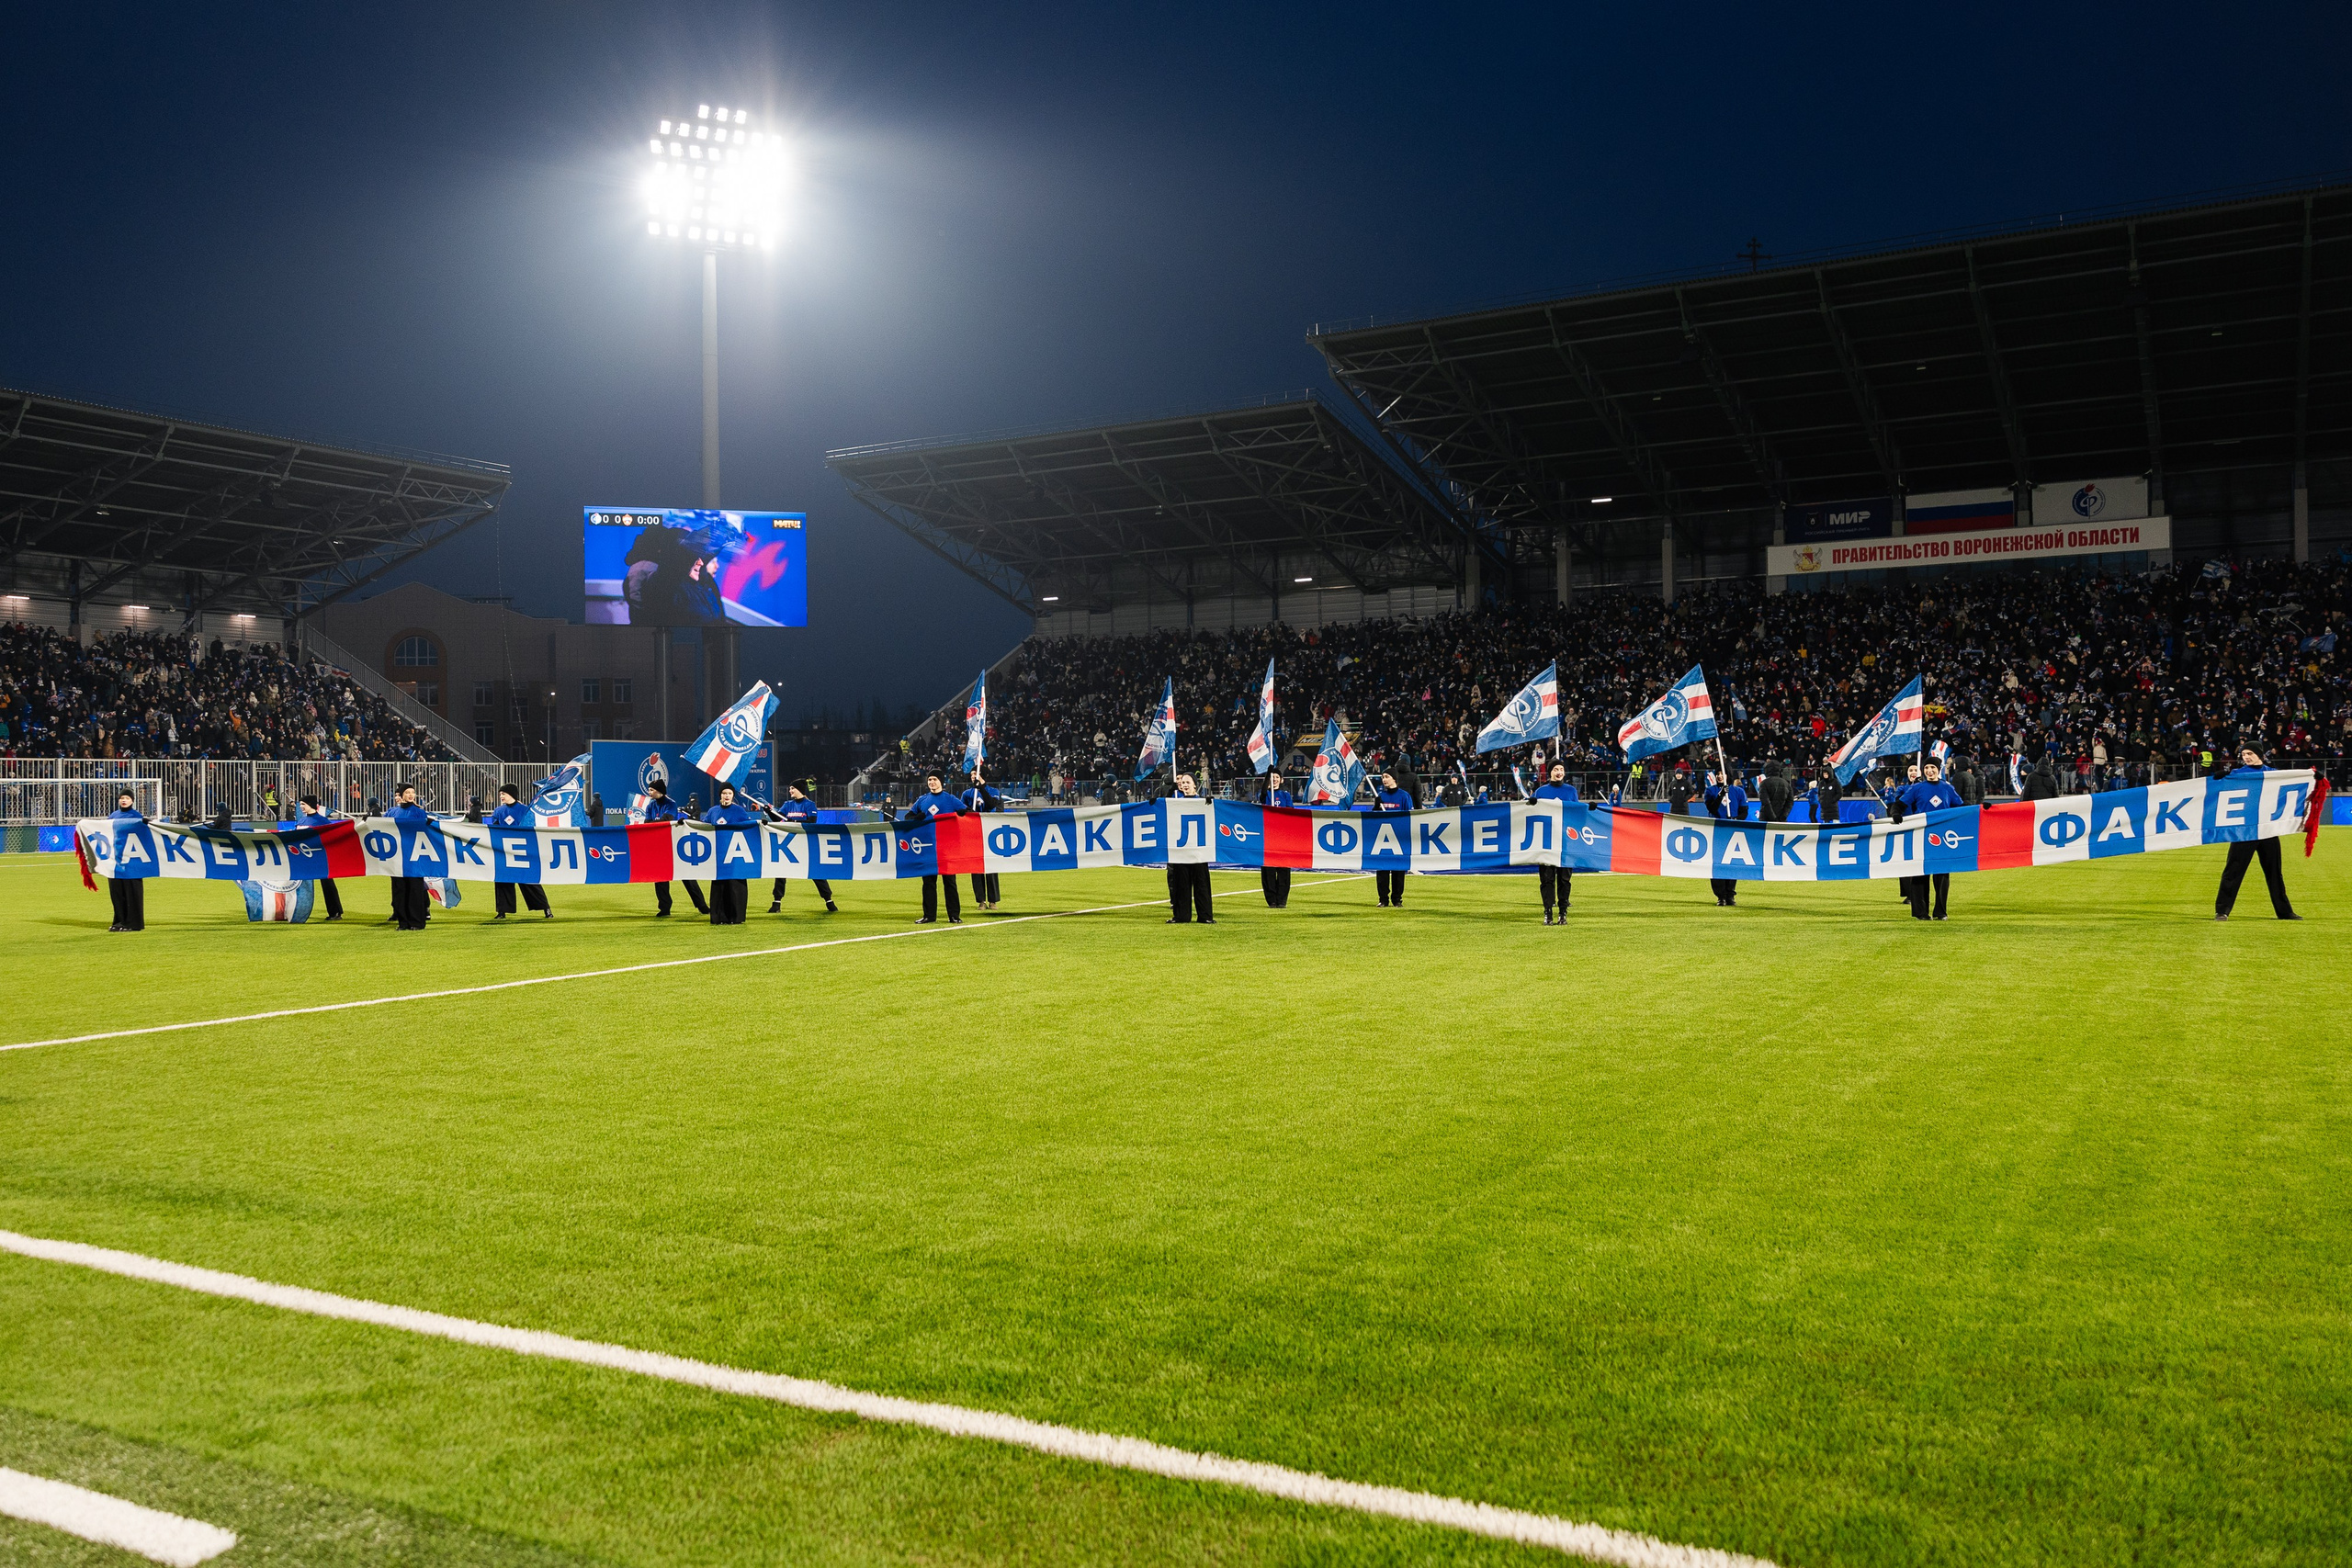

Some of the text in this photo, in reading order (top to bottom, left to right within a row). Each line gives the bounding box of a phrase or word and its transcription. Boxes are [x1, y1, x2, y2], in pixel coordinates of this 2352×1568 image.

[602, 514, 660, 525] 0 0 0:00
[1829, 510, 1871, 525] МИР
[1832, 526, 2140, 564] ПРАВИТЕЛЬСТВО ВОРОНЕЖСКОЙ ОБЛАСТИ
[2040, 783, 2310, 848] ФАКЕЛ
[87, 830, 282, 866] ФАКЕЛ
[364, 830, 578, 870] ФАКЕЛ
[676, 831, 888, 866] ФАКЕЛ
[988, 814, 1206, 857] ФАКЕЛ
[1317, 815, 1552, 855] ФАКЕЛ
[1666, 828, 1914, 866] ФАКЕЛ
